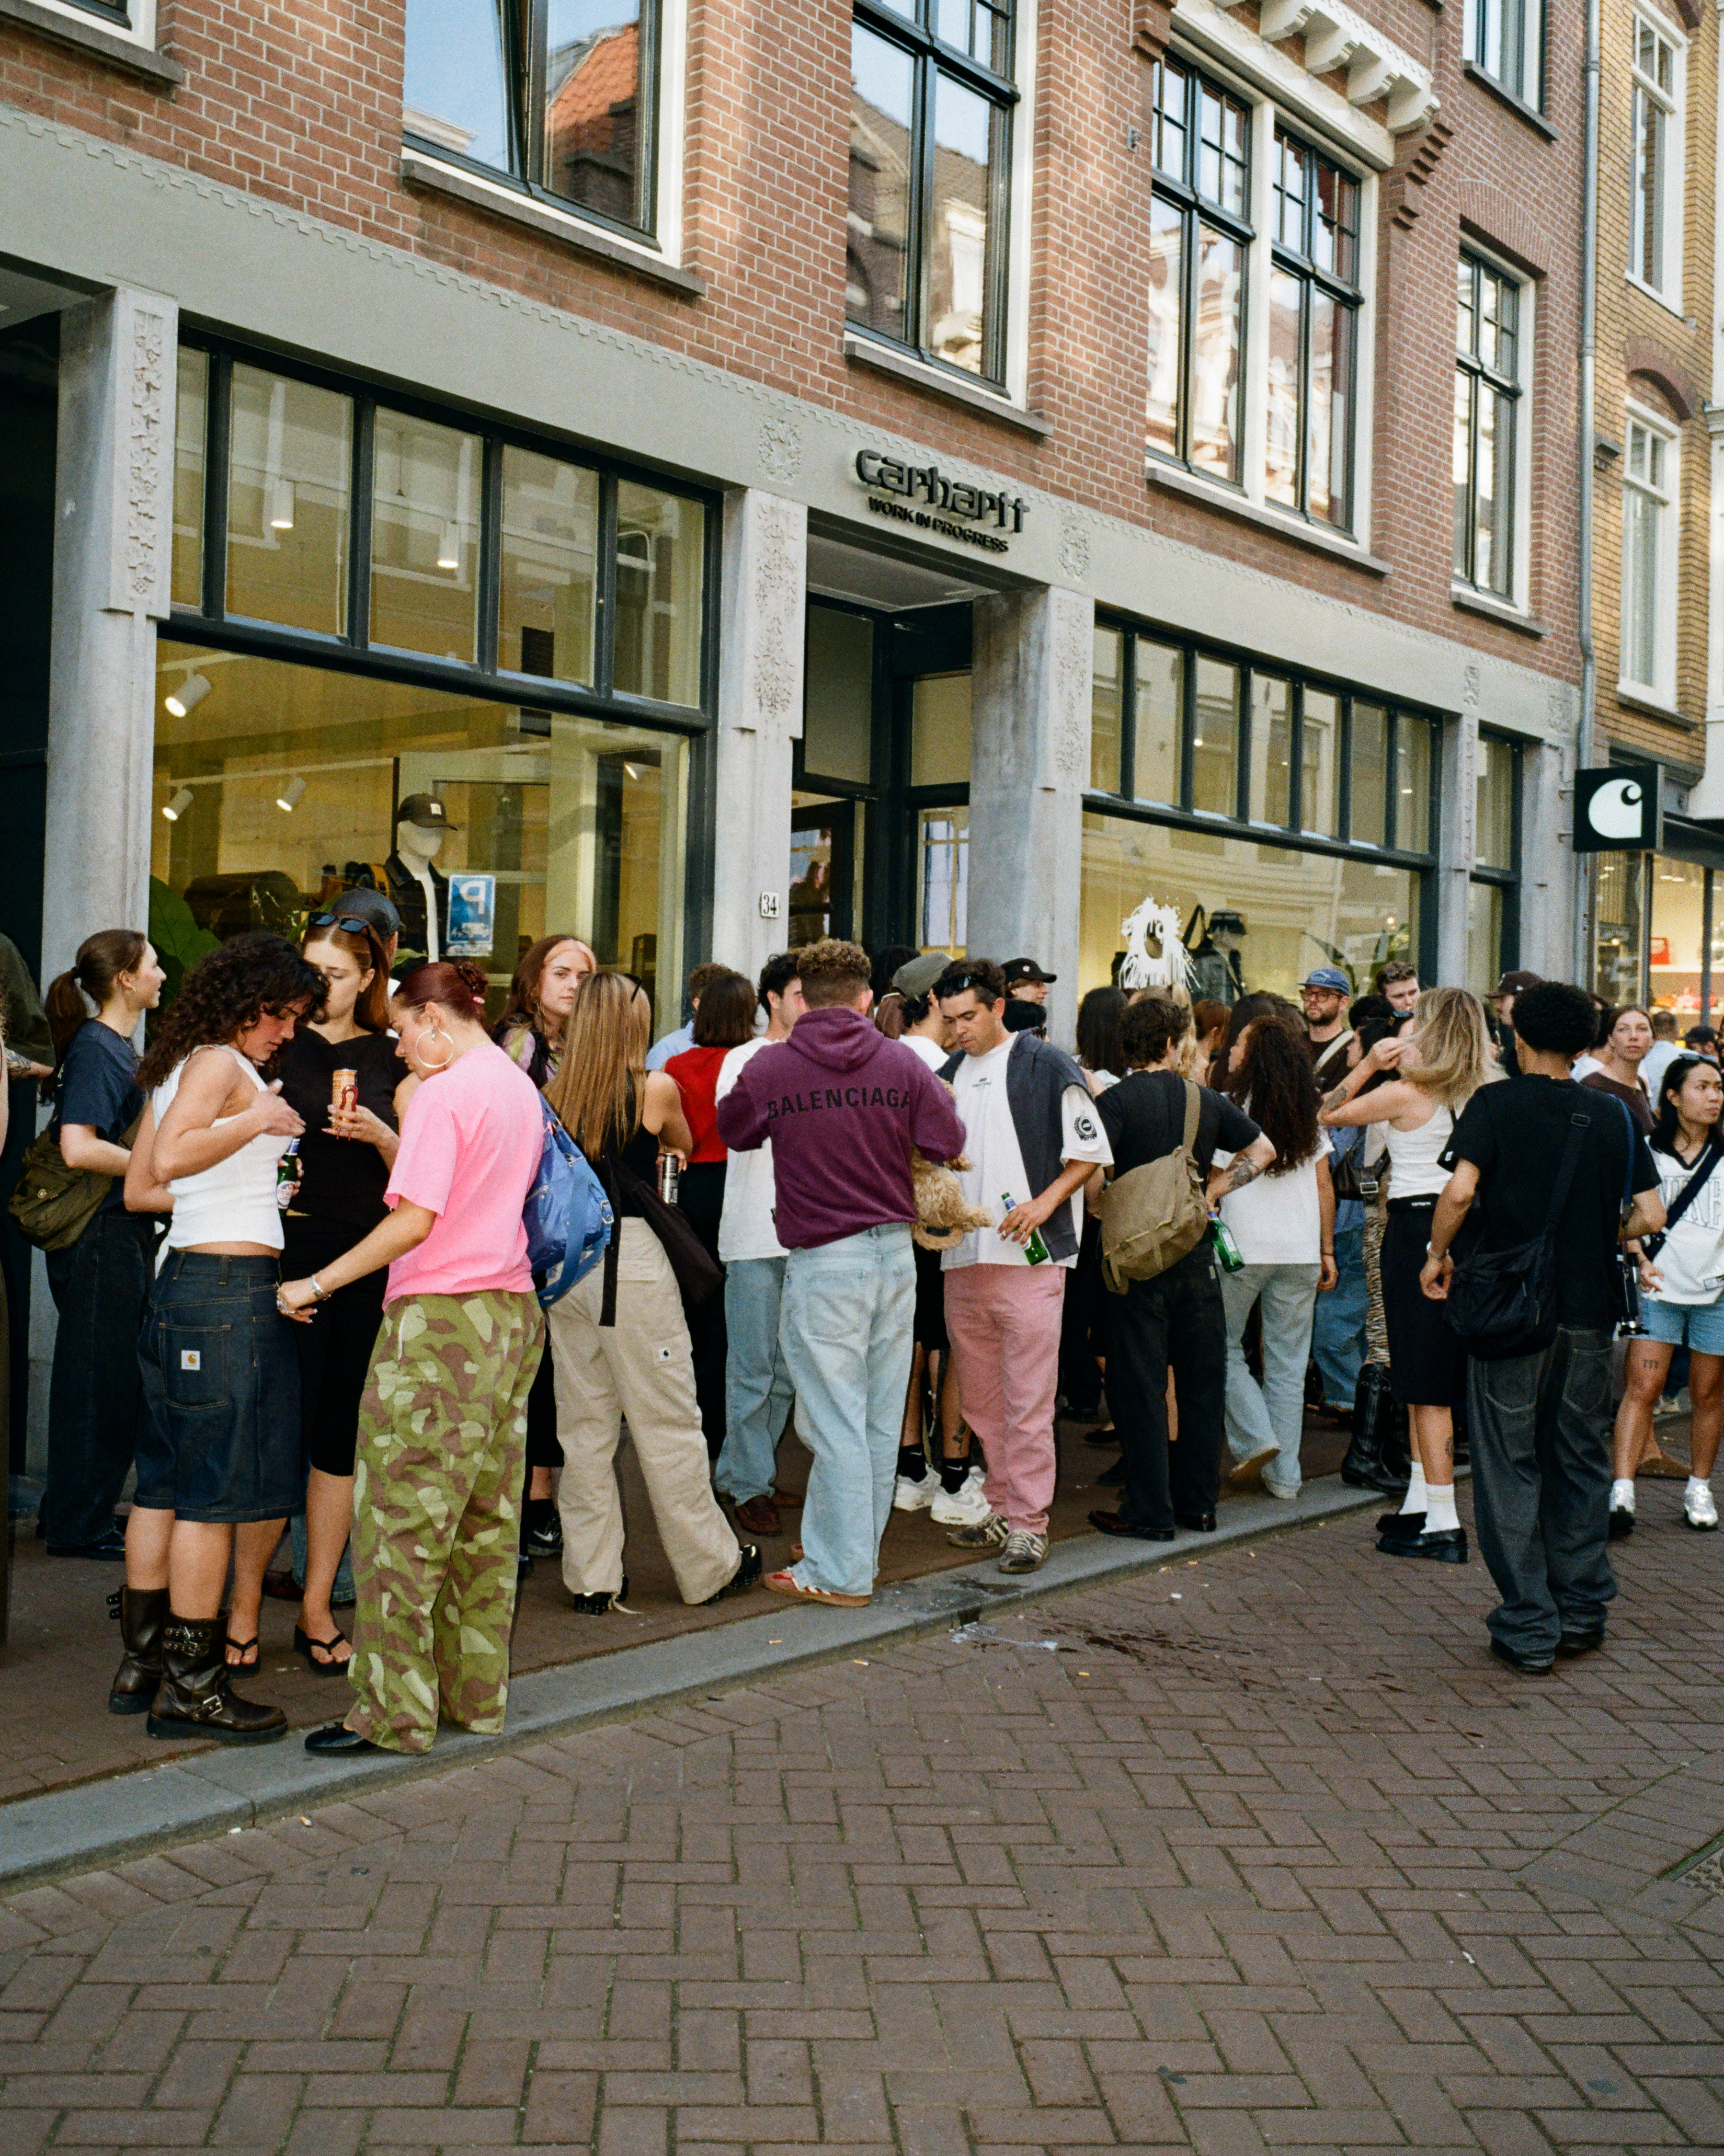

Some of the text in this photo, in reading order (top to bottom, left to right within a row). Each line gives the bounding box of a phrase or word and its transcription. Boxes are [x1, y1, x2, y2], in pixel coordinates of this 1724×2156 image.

[856, 449, 1030, 533] carhartt
[868, 496, 1009, 551] WORK IN PROGRESS
[764, 895, 776, 915] 34
[767, 1088, 909, 1120] BALENCIAGA
